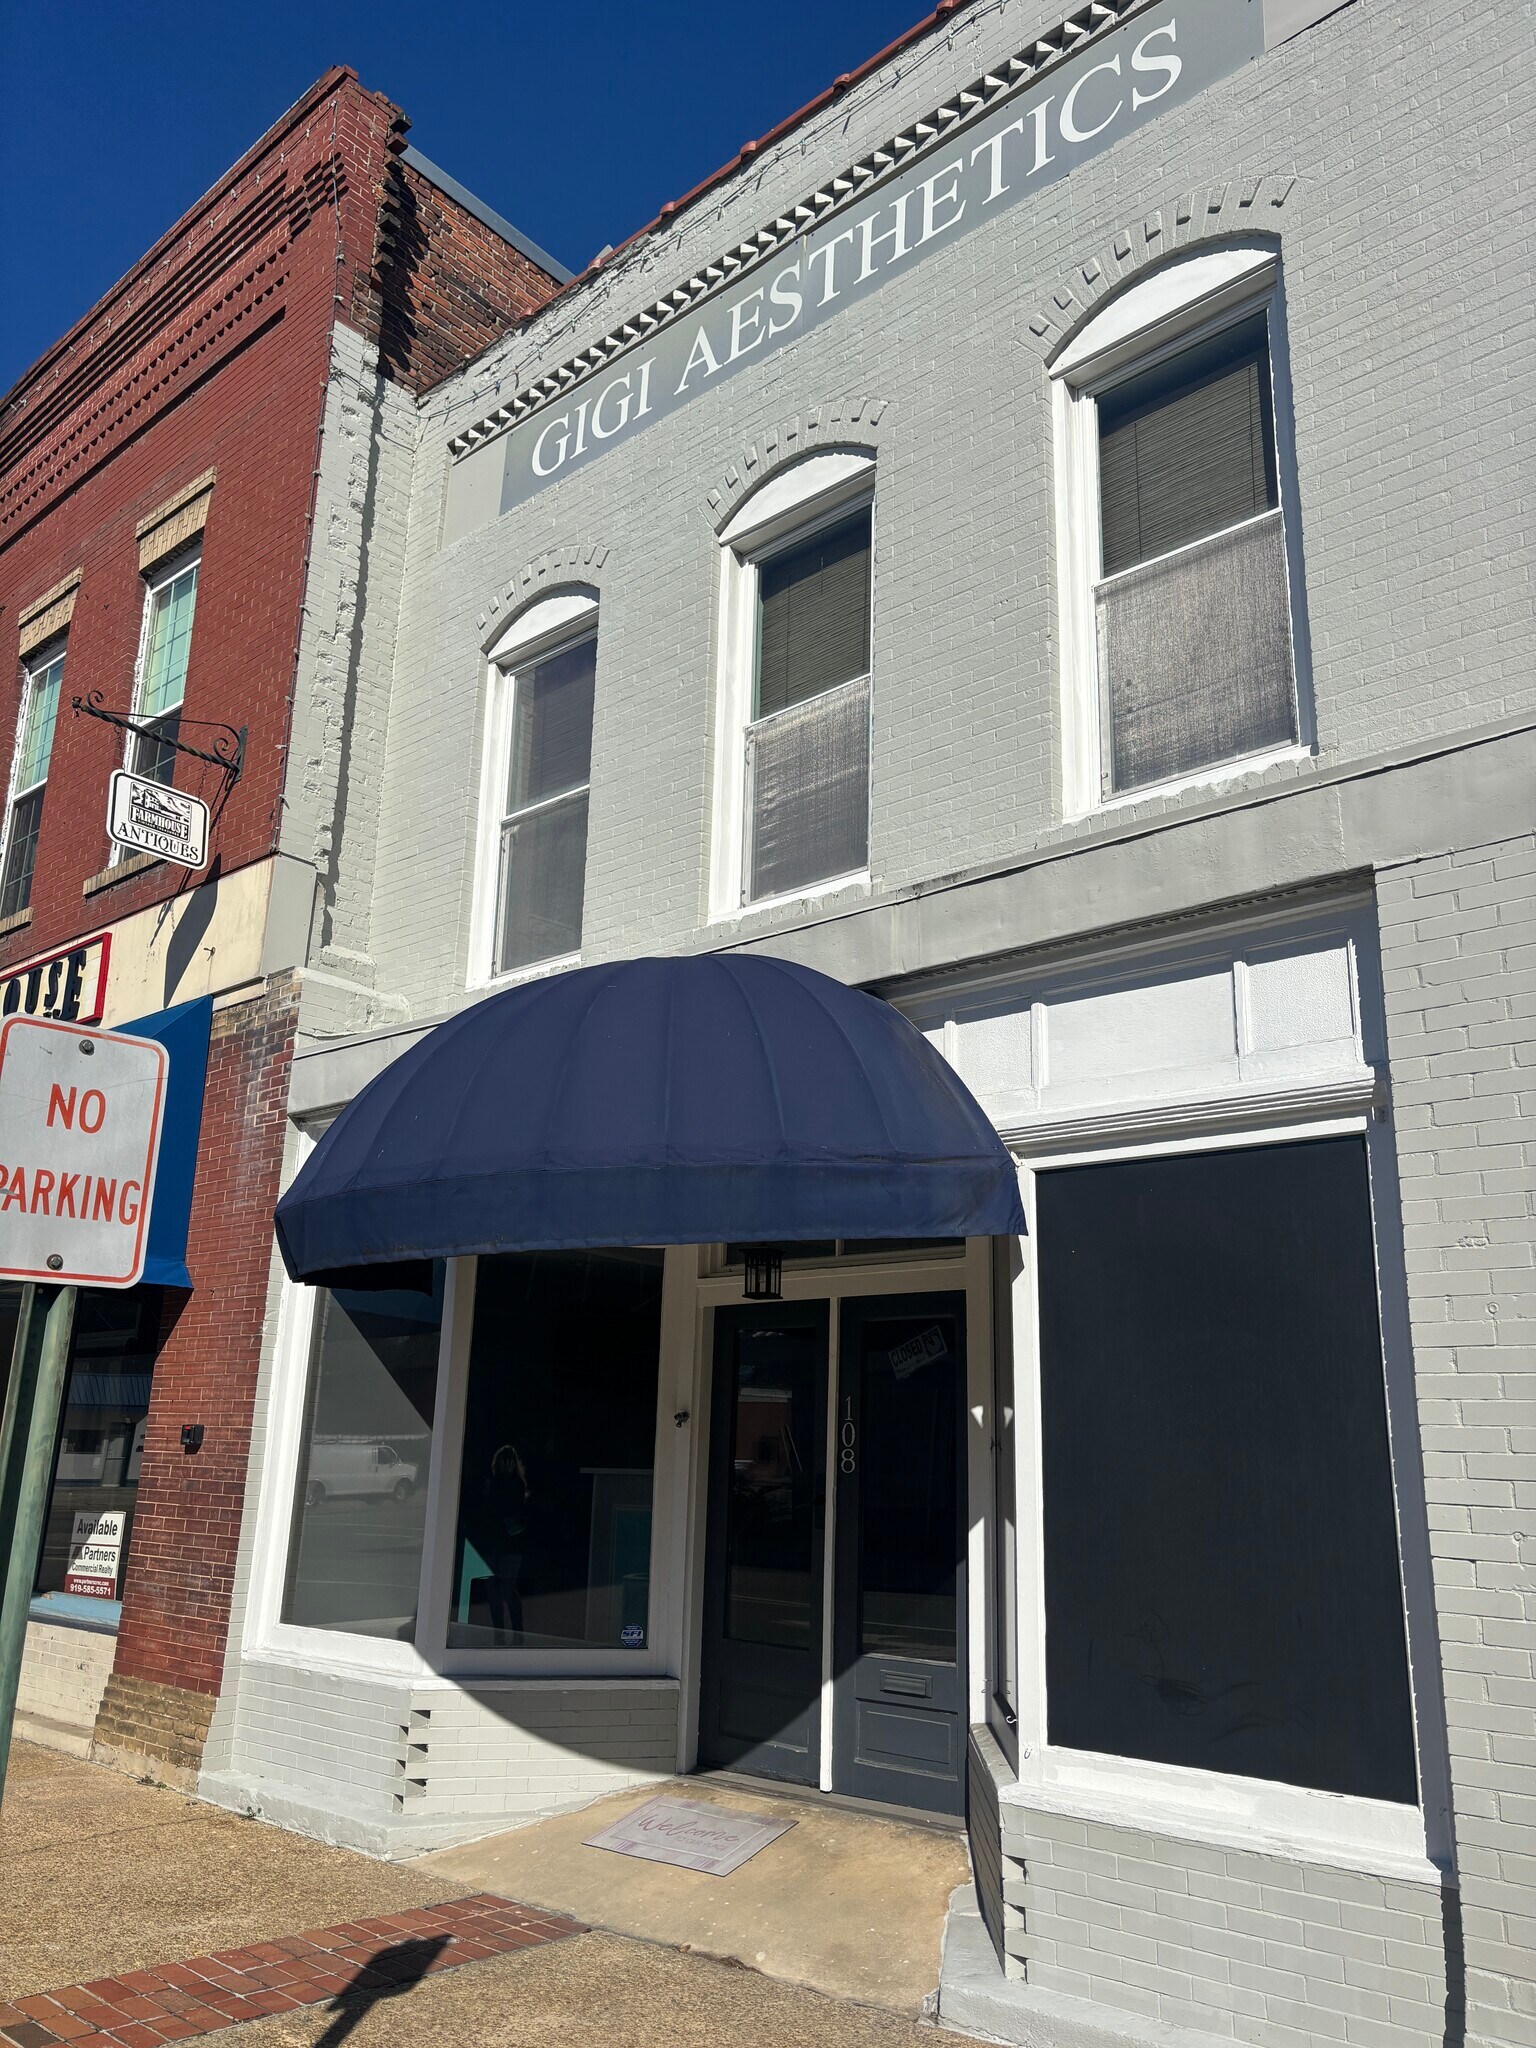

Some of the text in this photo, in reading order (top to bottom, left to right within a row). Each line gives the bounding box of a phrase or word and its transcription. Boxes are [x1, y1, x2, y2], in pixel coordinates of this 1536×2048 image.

[531, 17, 1183, 478] GIGI AESTHETICS
[131, 806, 188, 839] FARMHOUSE
[117, 821, 199, 861] ANTIQUES
[0, 949, 87, 1020] OUSE
[46, 1083, 107, 1134] NO
[891, 1338, 923, 1367] CLOSED
[840, 1395, 856, 1474] 108
[76, 1518, 118, 1536] Available
[71, 1562, 113, 1577] Commercial Realty
[83, 1546, 117, 1562] Partners
[69, 1583, 111, 1596] 919-585-5571
[638, 1814, 740, 1842] Welcome
